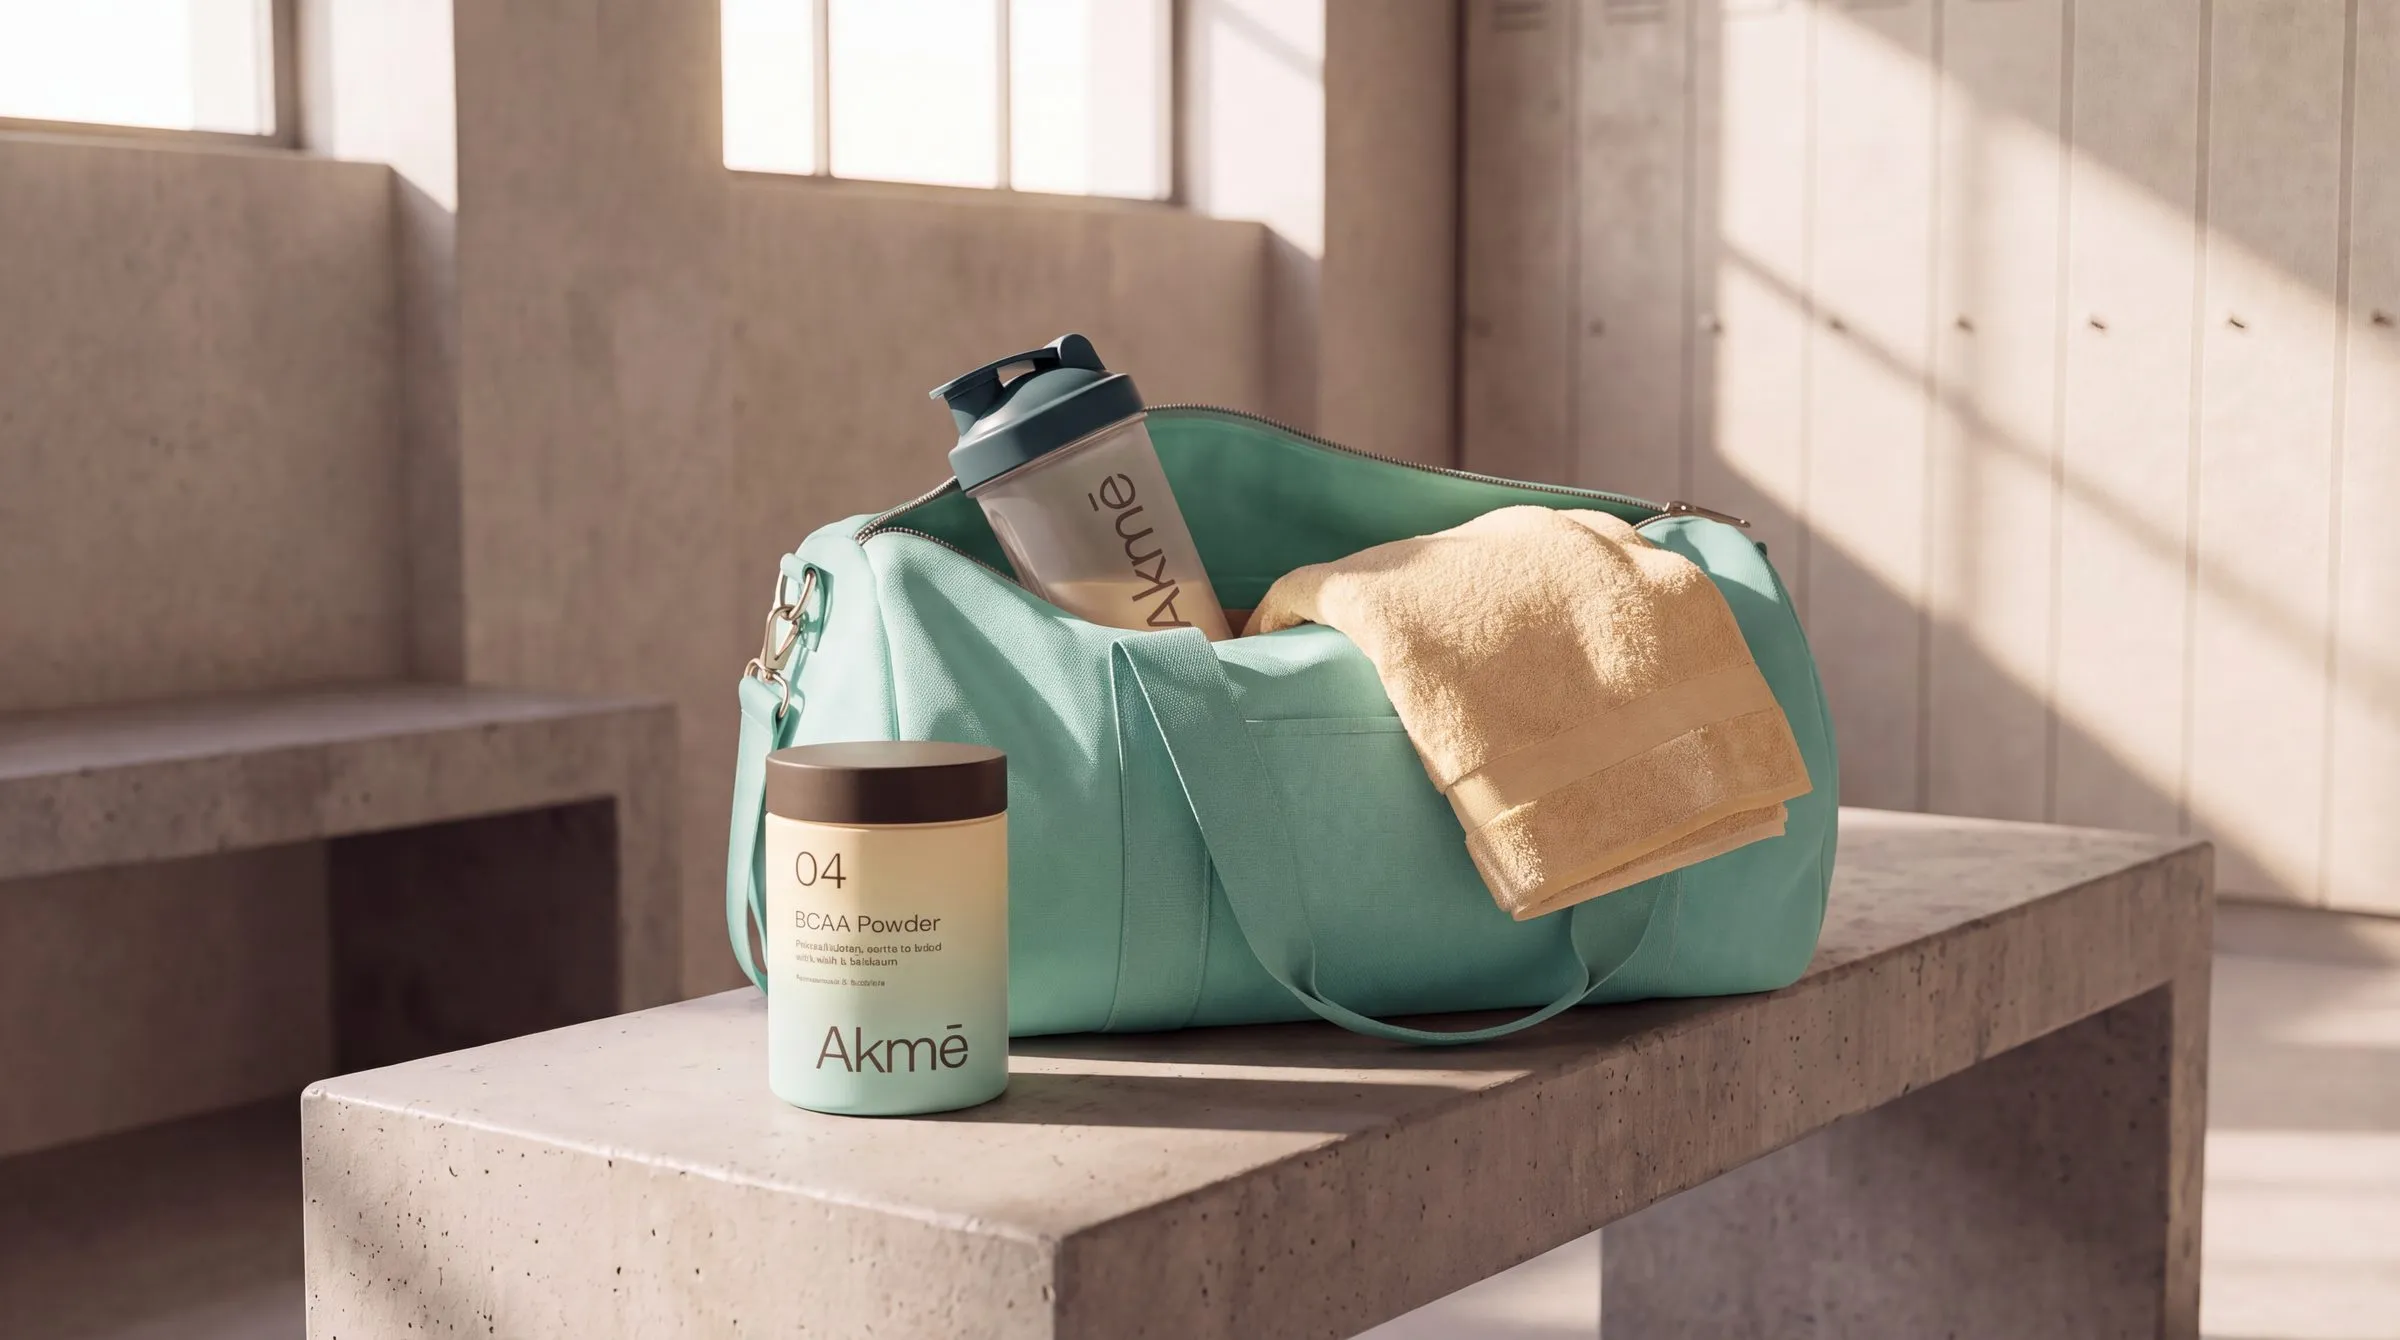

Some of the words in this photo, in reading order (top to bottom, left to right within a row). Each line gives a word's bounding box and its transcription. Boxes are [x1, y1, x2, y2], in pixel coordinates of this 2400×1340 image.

[1088, 473, 1193, 627] Akmē
[795, 851, 847, 889] 04
[795, 910, 851, 933] BCAA
[858, 914, 942, 933] Powder
[816, 1024, 969, 1073] Akmē
